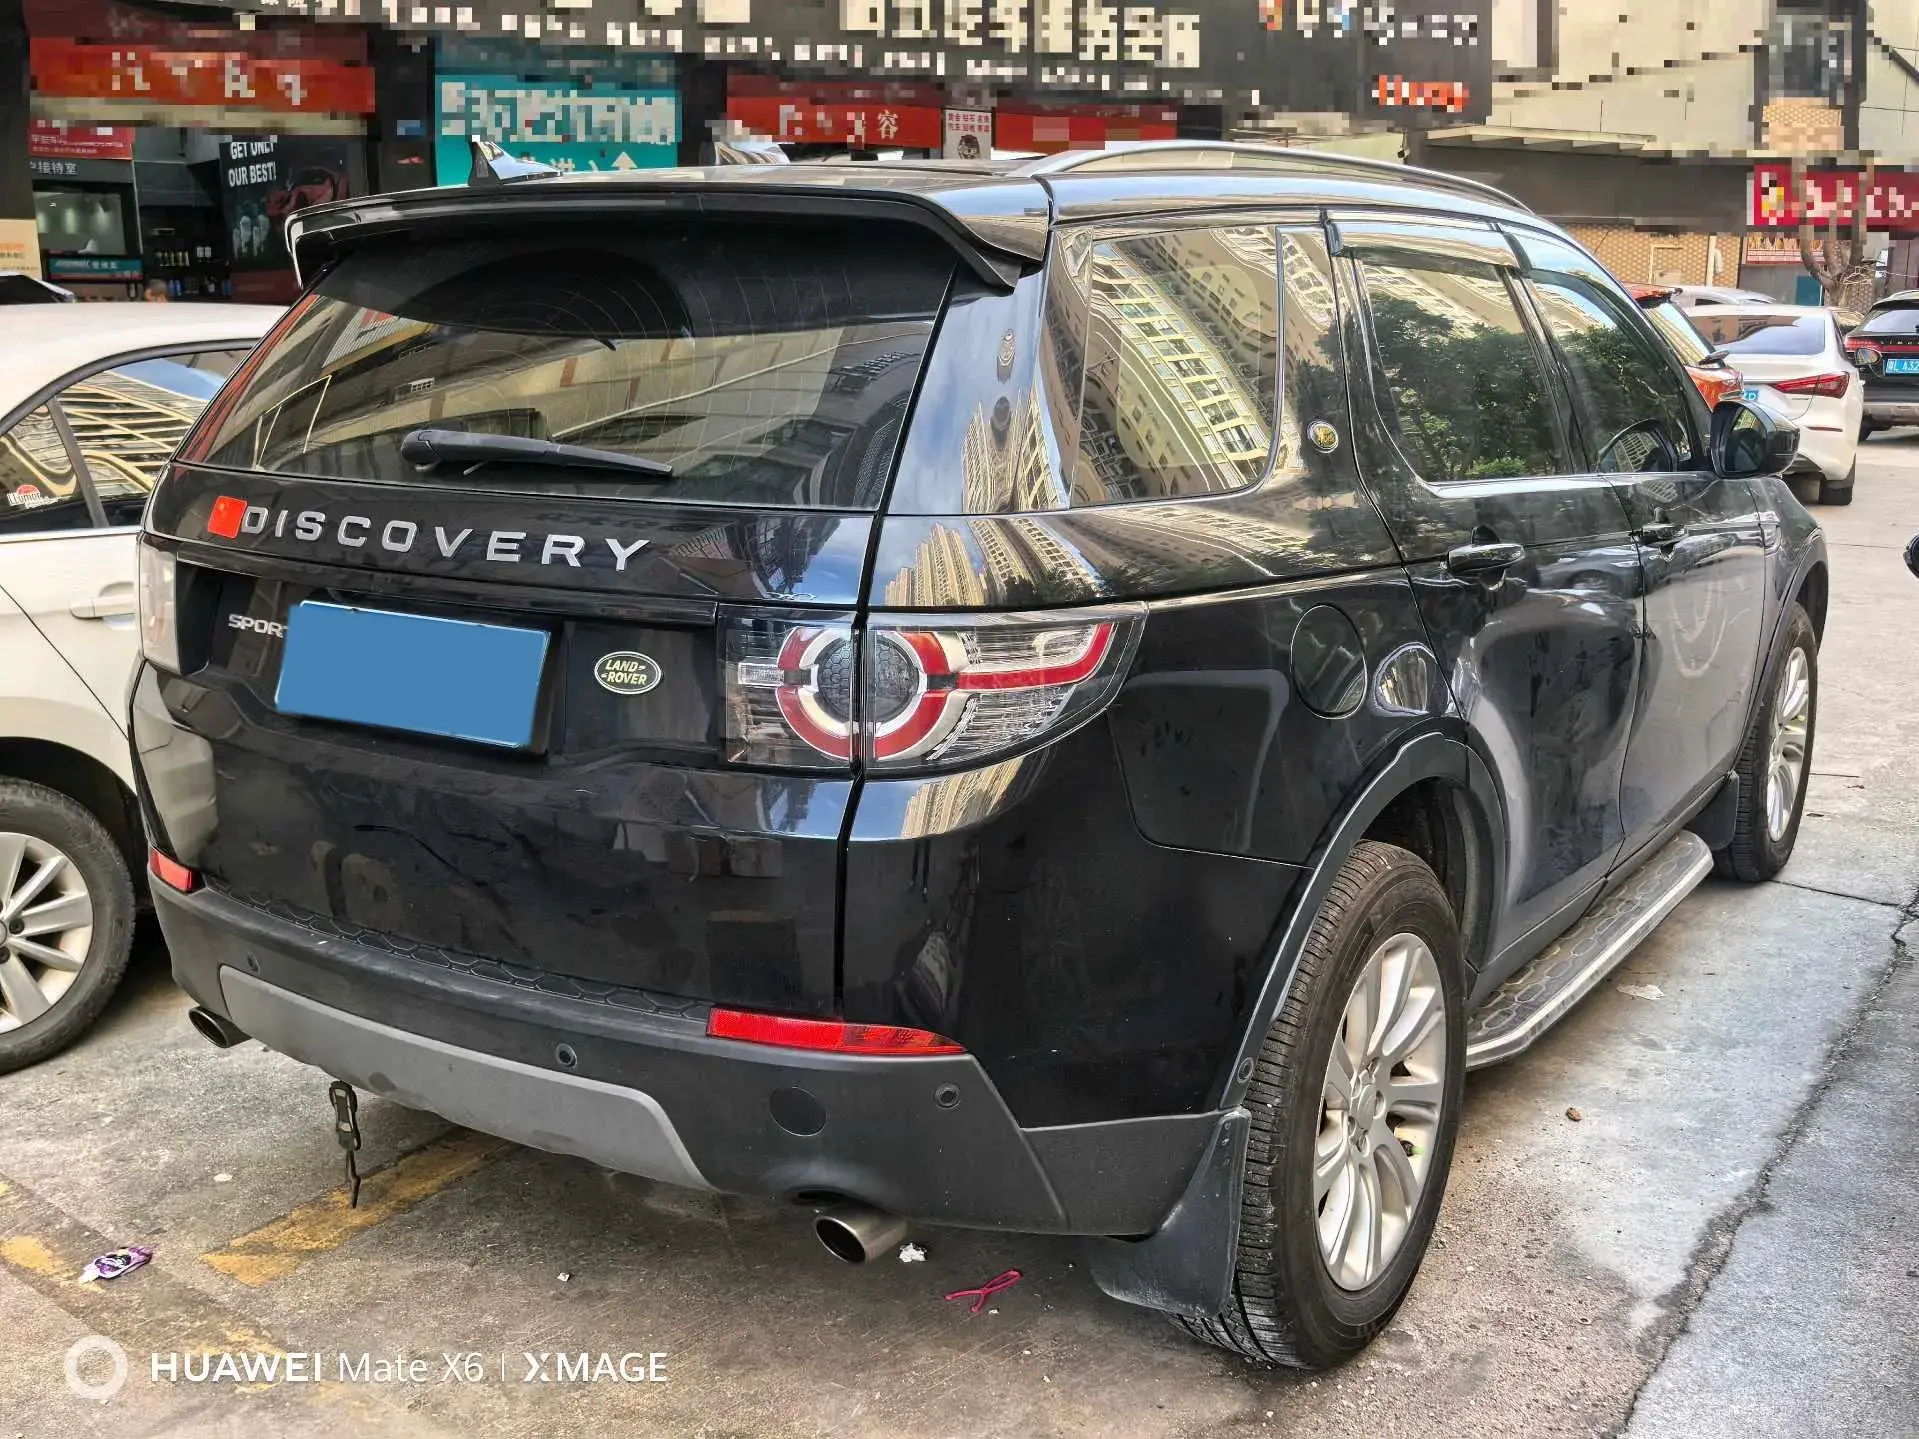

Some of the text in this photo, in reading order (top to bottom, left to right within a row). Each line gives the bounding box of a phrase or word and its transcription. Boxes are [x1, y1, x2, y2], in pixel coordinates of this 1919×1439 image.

[230, 141, 249, 160] GET
[228, 161, 277, 187] OUR BEST!
[240, 506, 651, 572] DISCOVERY
